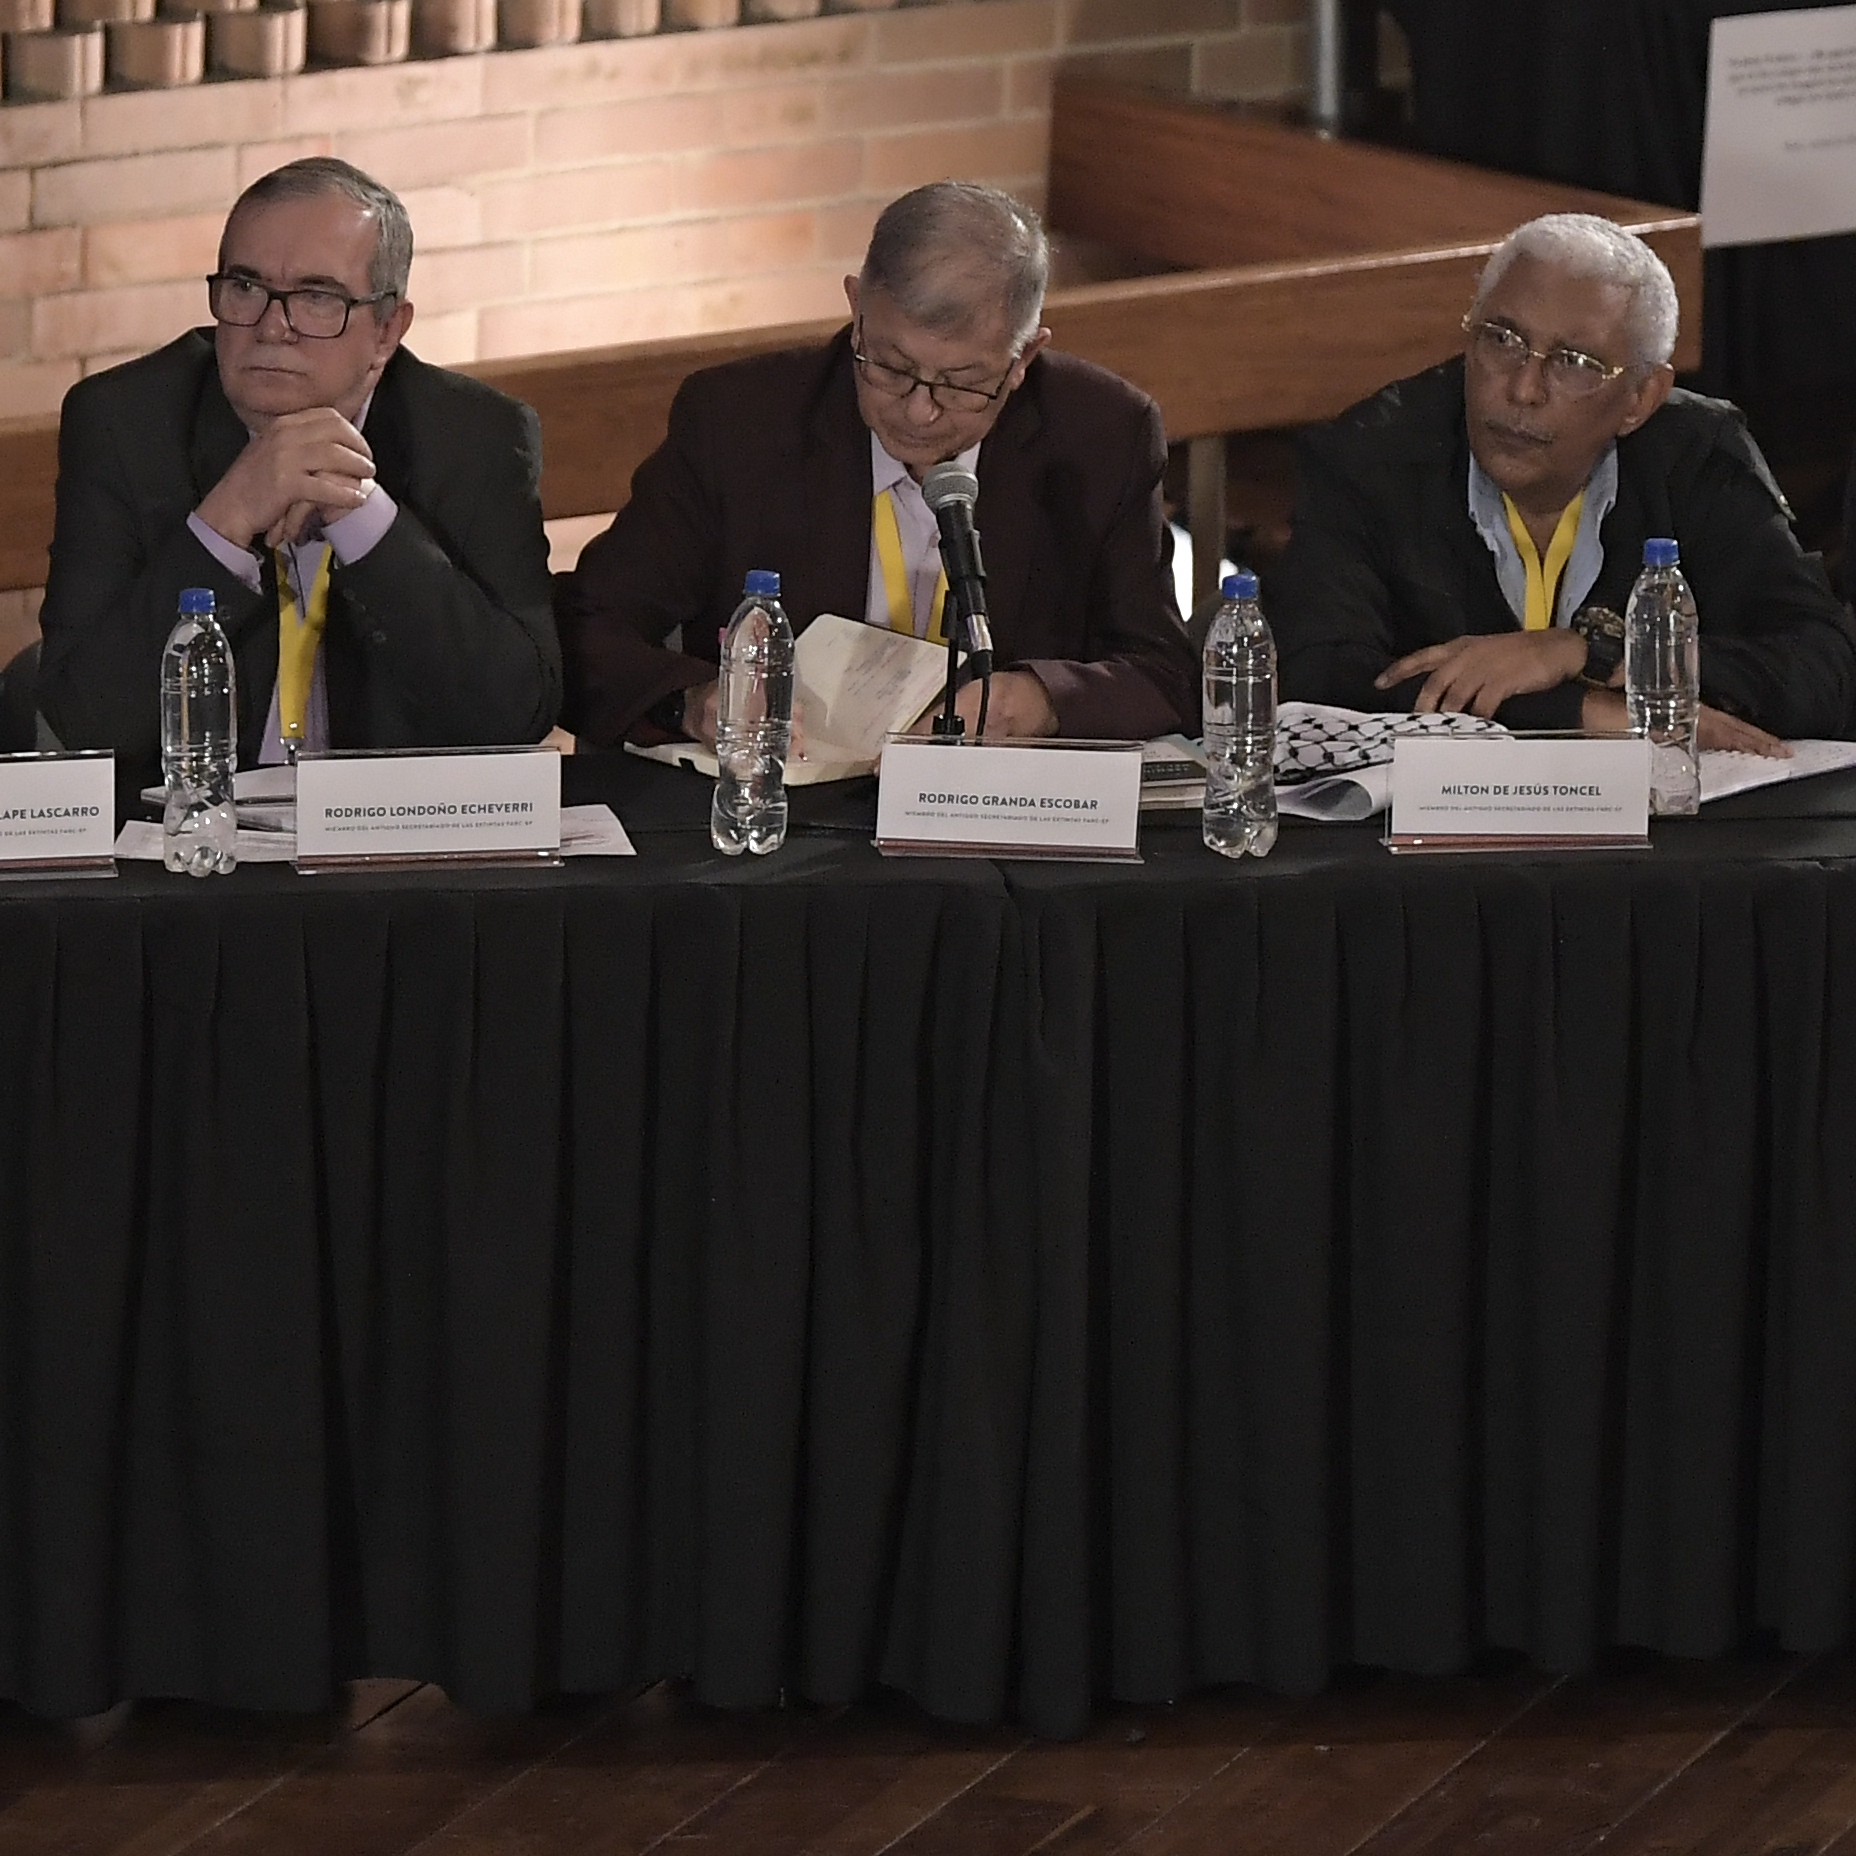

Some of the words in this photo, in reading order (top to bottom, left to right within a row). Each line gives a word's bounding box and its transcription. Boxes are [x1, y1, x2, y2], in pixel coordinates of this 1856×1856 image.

[1441, 785, 1489, 796] MILTON
[1493, 785, 1510, 796] DE
[1512, 783, 1549, 796] JESÚS
[1552, 785, 1602, 796] TONCEL
[918, 792, 979, 806] RODRIGO
[982, 795, 1037, 808] GRANDA
[1039, 797, 1099, 810] ESCOBAR
[30, 806, 100, 819] LASCARRO
[325, 806, 387, 818] RODRIGO
[390, 802, 457, 817] LONDOÑO
[461, 802, 533, 815] ECHEVERRI
